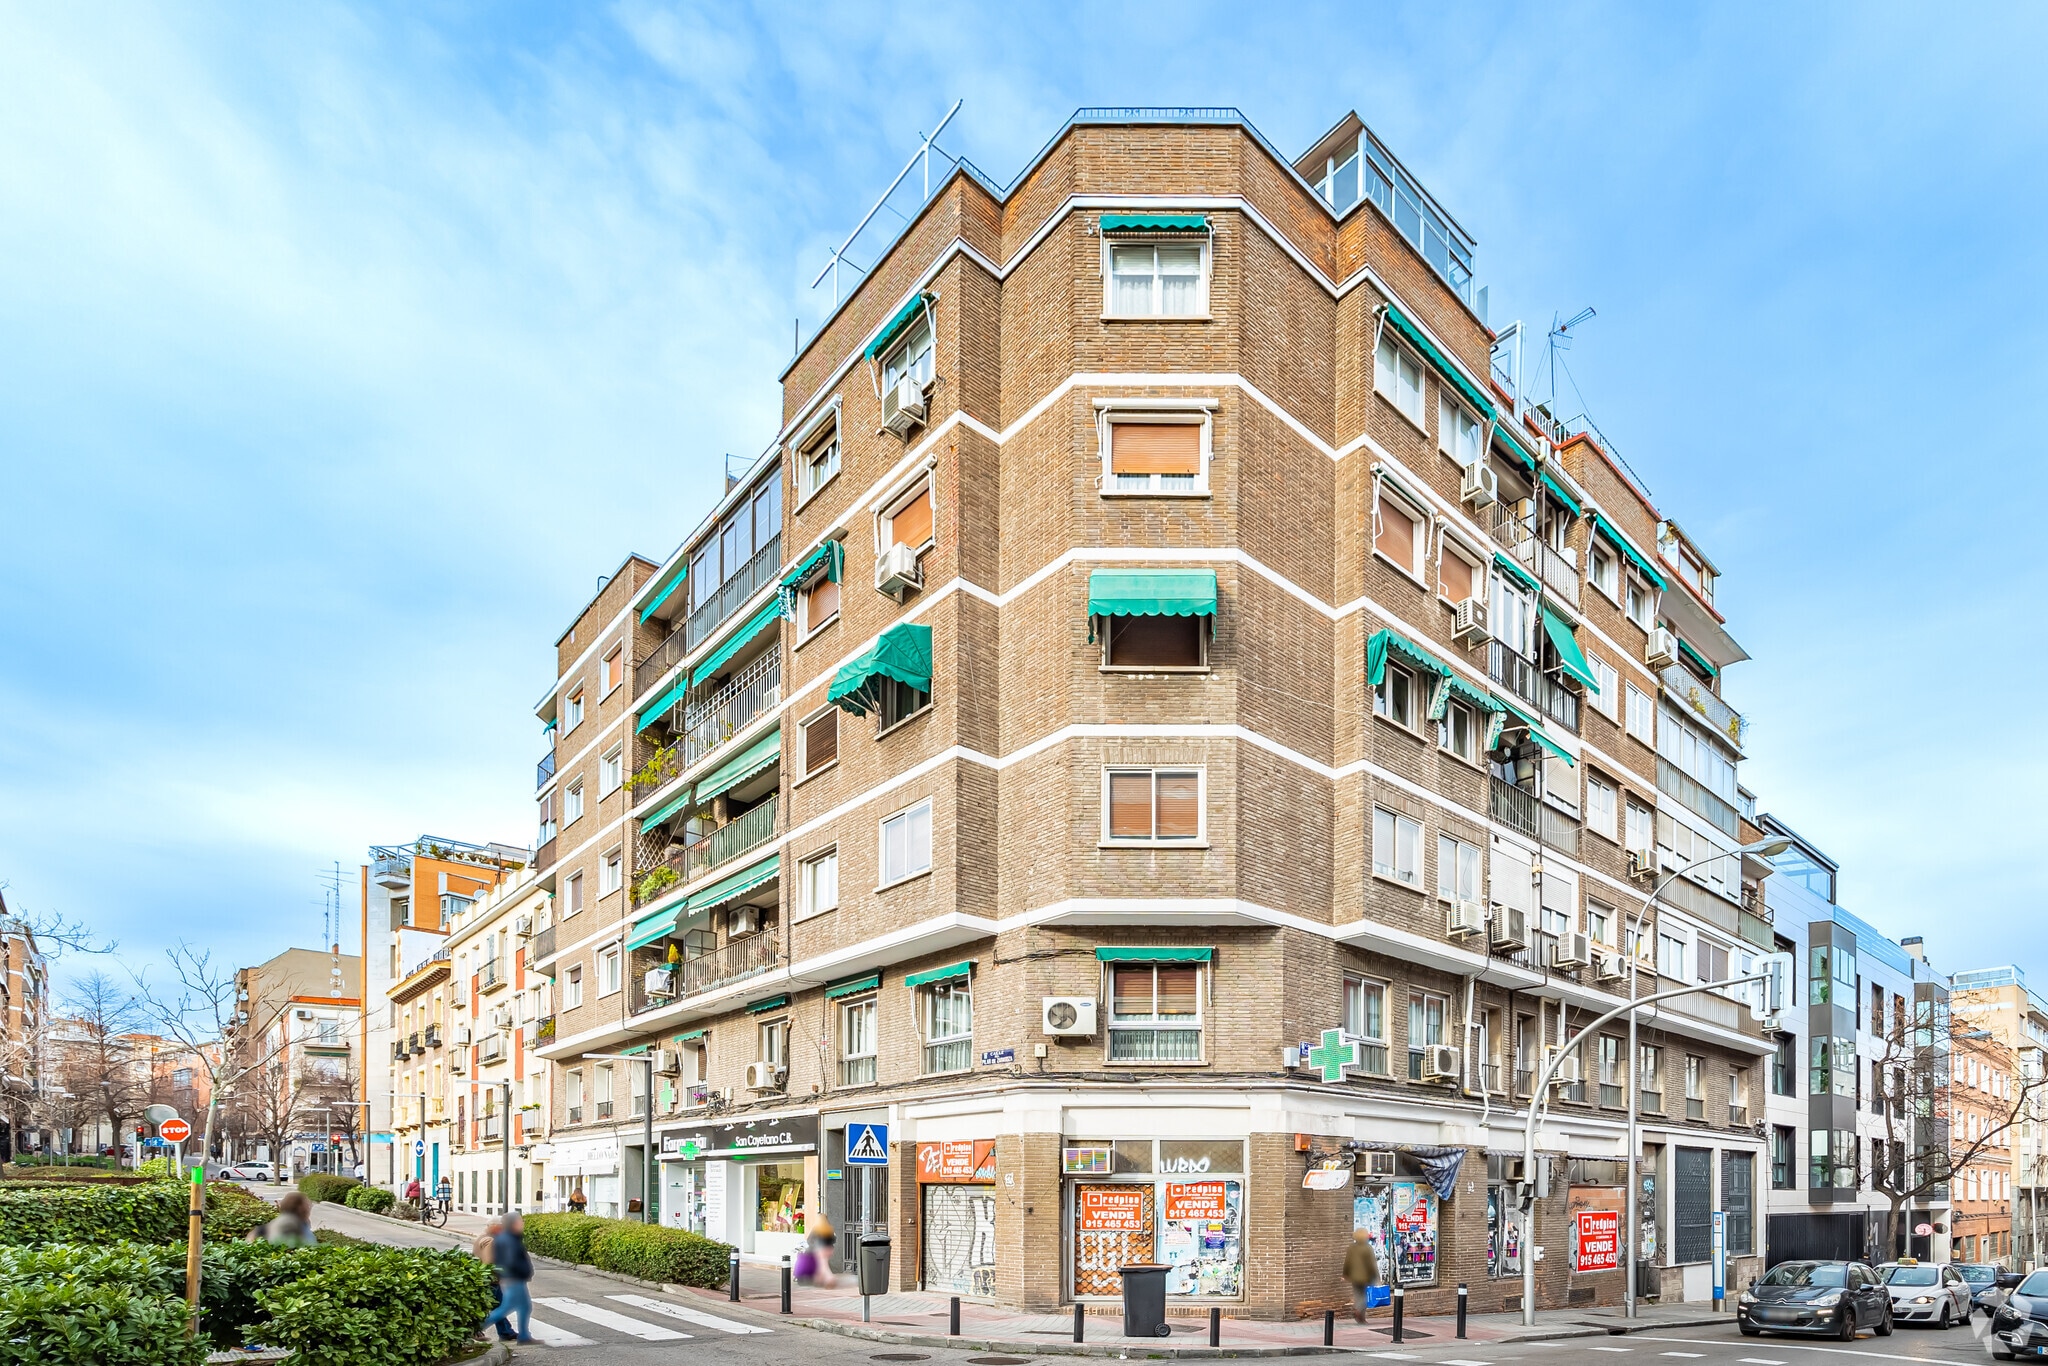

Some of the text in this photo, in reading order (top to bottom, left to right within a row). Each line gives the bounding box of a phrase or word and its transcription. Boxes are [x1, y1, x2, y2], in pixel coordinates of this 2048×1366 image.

[162, 1126, 189, 1135] STOP
[663, 1133, 707, 1152] Farmia
[735, 1136, 747, 1148] San
[747, 1134, 779, 1149] Cayetano
[946, 1158, 969, 1166] VENDE
[1185, 1184, 1223, 1194] redpiso
[1102, 1195, 1140, 1205] redpiso
[1175, 1200, 1219, 1209] VENDE
[1091, 1210, 1135, 1220] VENDE
[1169, 1209, 1224, 1218] 915 465 453
[1085, 1219, 1140, 1228] 915 465 453
[1592, 1218, 1616, 1231] redpiso
[1584, 1240, 1614, 1254] VENDE
[1580, 1252, 1617, 1267] 915 465 453
